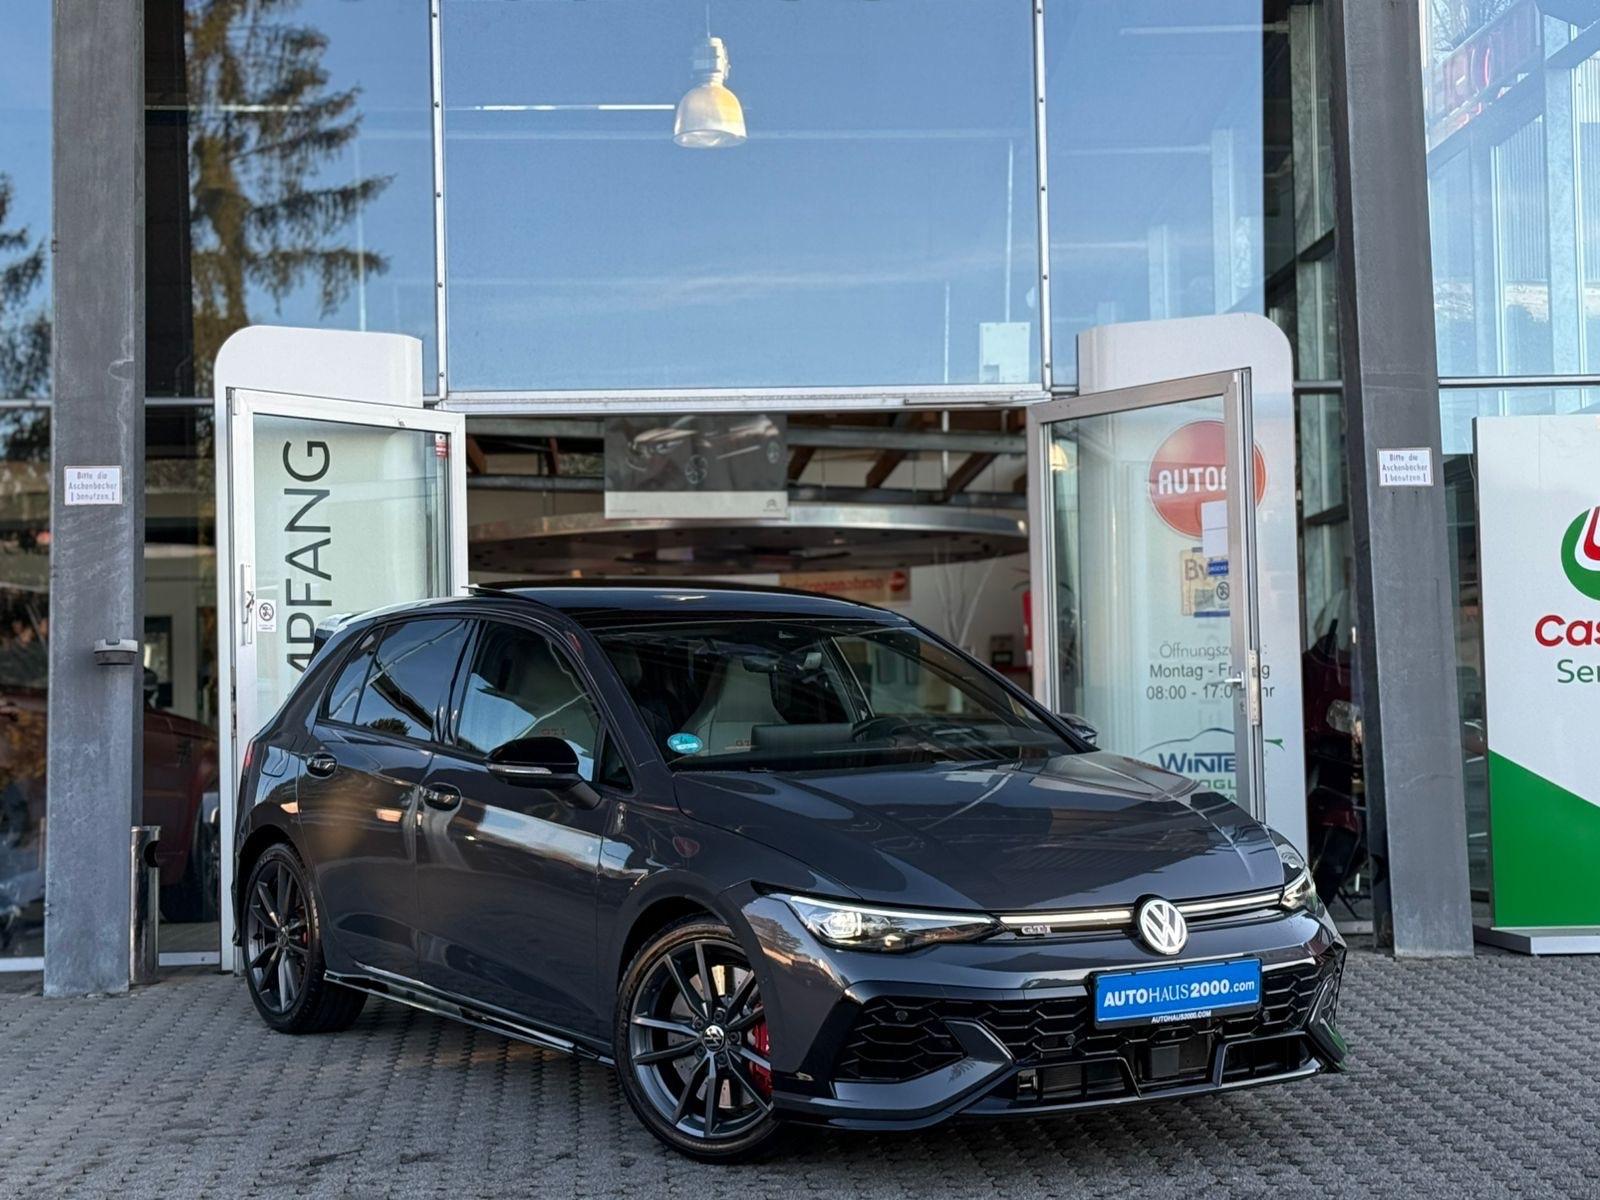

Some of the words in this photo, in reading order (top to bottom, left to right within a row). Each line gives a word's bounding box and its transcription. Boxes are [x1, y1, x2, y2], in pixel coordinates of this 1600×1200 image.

[77, 472, 93, 480] Bitte
[1149, 663, 1203, 681] Montag
[1146, 684, 1187, 700] 08:00
[1202, 683, 1234, 699] 17:0
[1021, 925, 1052, 935] GTI
[1104, 979, 1255, 1007] AUTOHAUS2000.com
